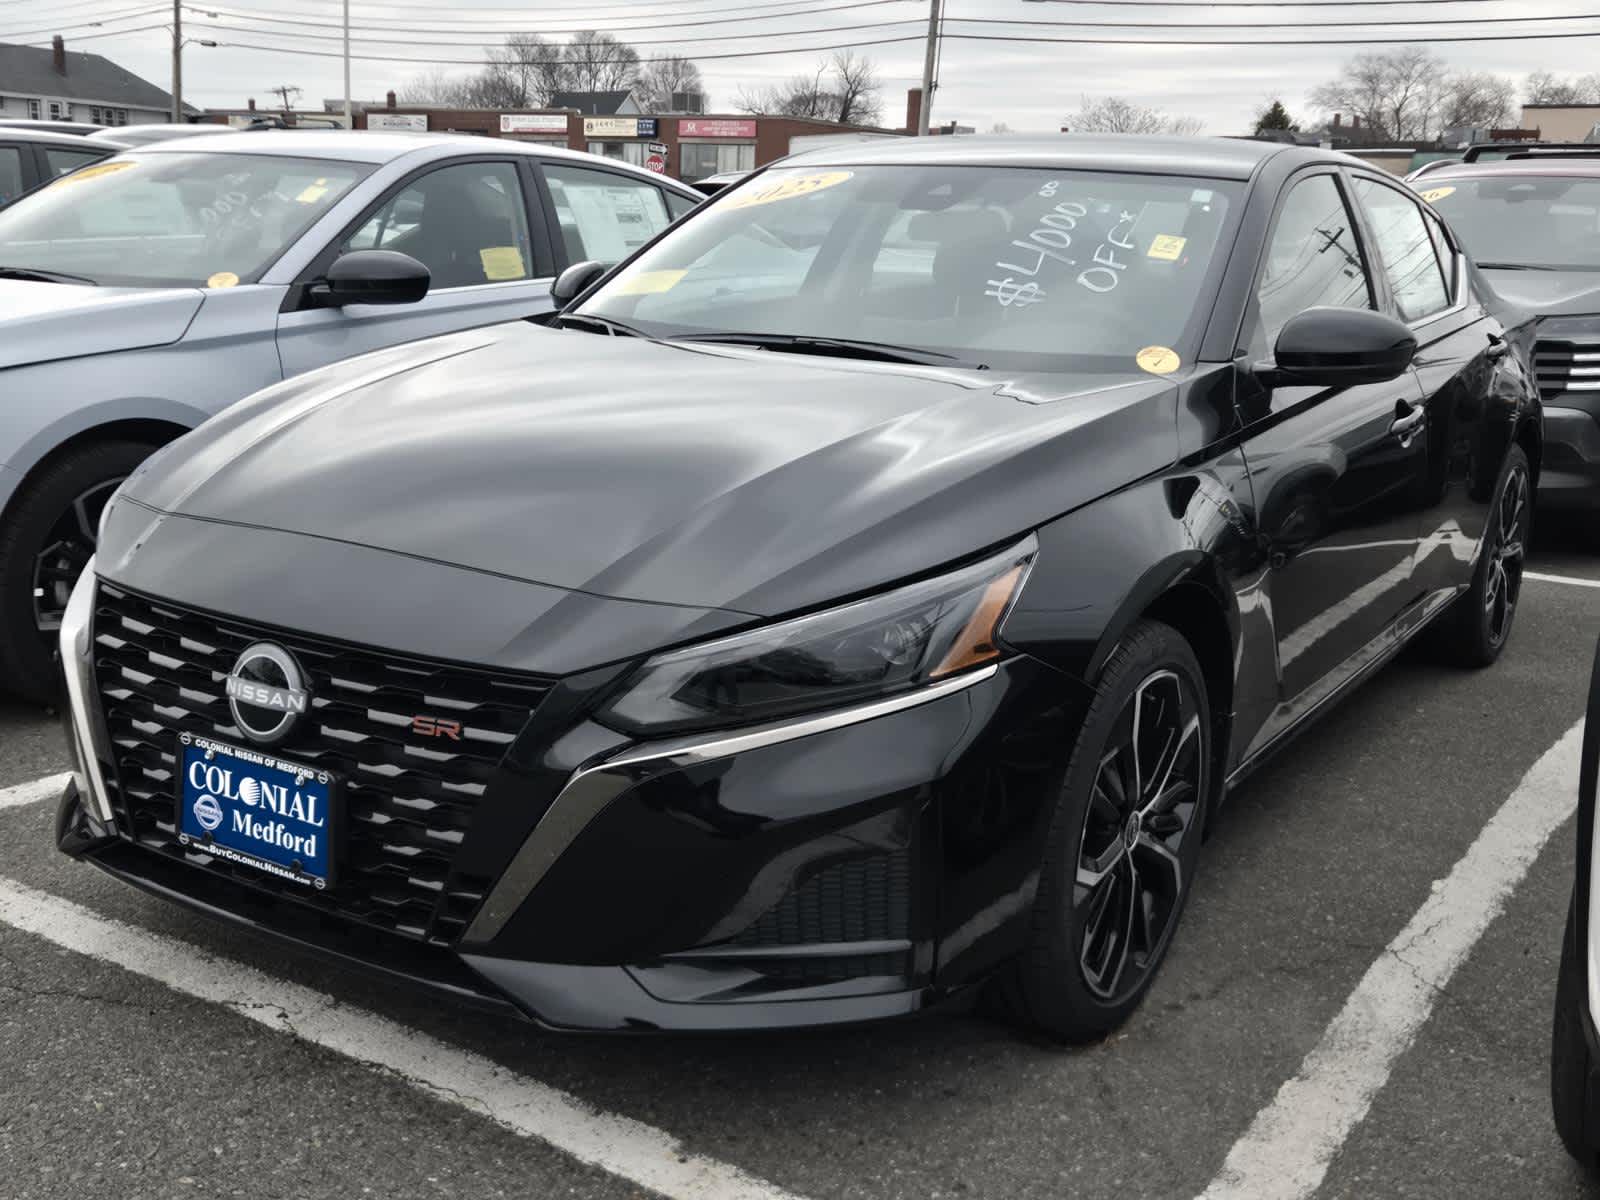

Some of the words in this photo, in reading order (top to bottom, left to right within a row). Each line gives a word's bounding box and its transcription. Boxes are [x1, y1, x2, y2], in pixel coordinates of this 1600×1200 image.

[648, 161, 663, 171] STOP
[226, 678, 306, 710] NISSAN
[412, 715, 461, 741] SR
[195, 739, 234, 756] COLONIAL
[235, 750, 263, 764] NISSAN
[265, 758, 275, 768] OF
[277, 761, 314, 779] MEDFORD
[189, 761, 324, 827] COLONIAL
[232, 809, 317, 857] Medford
